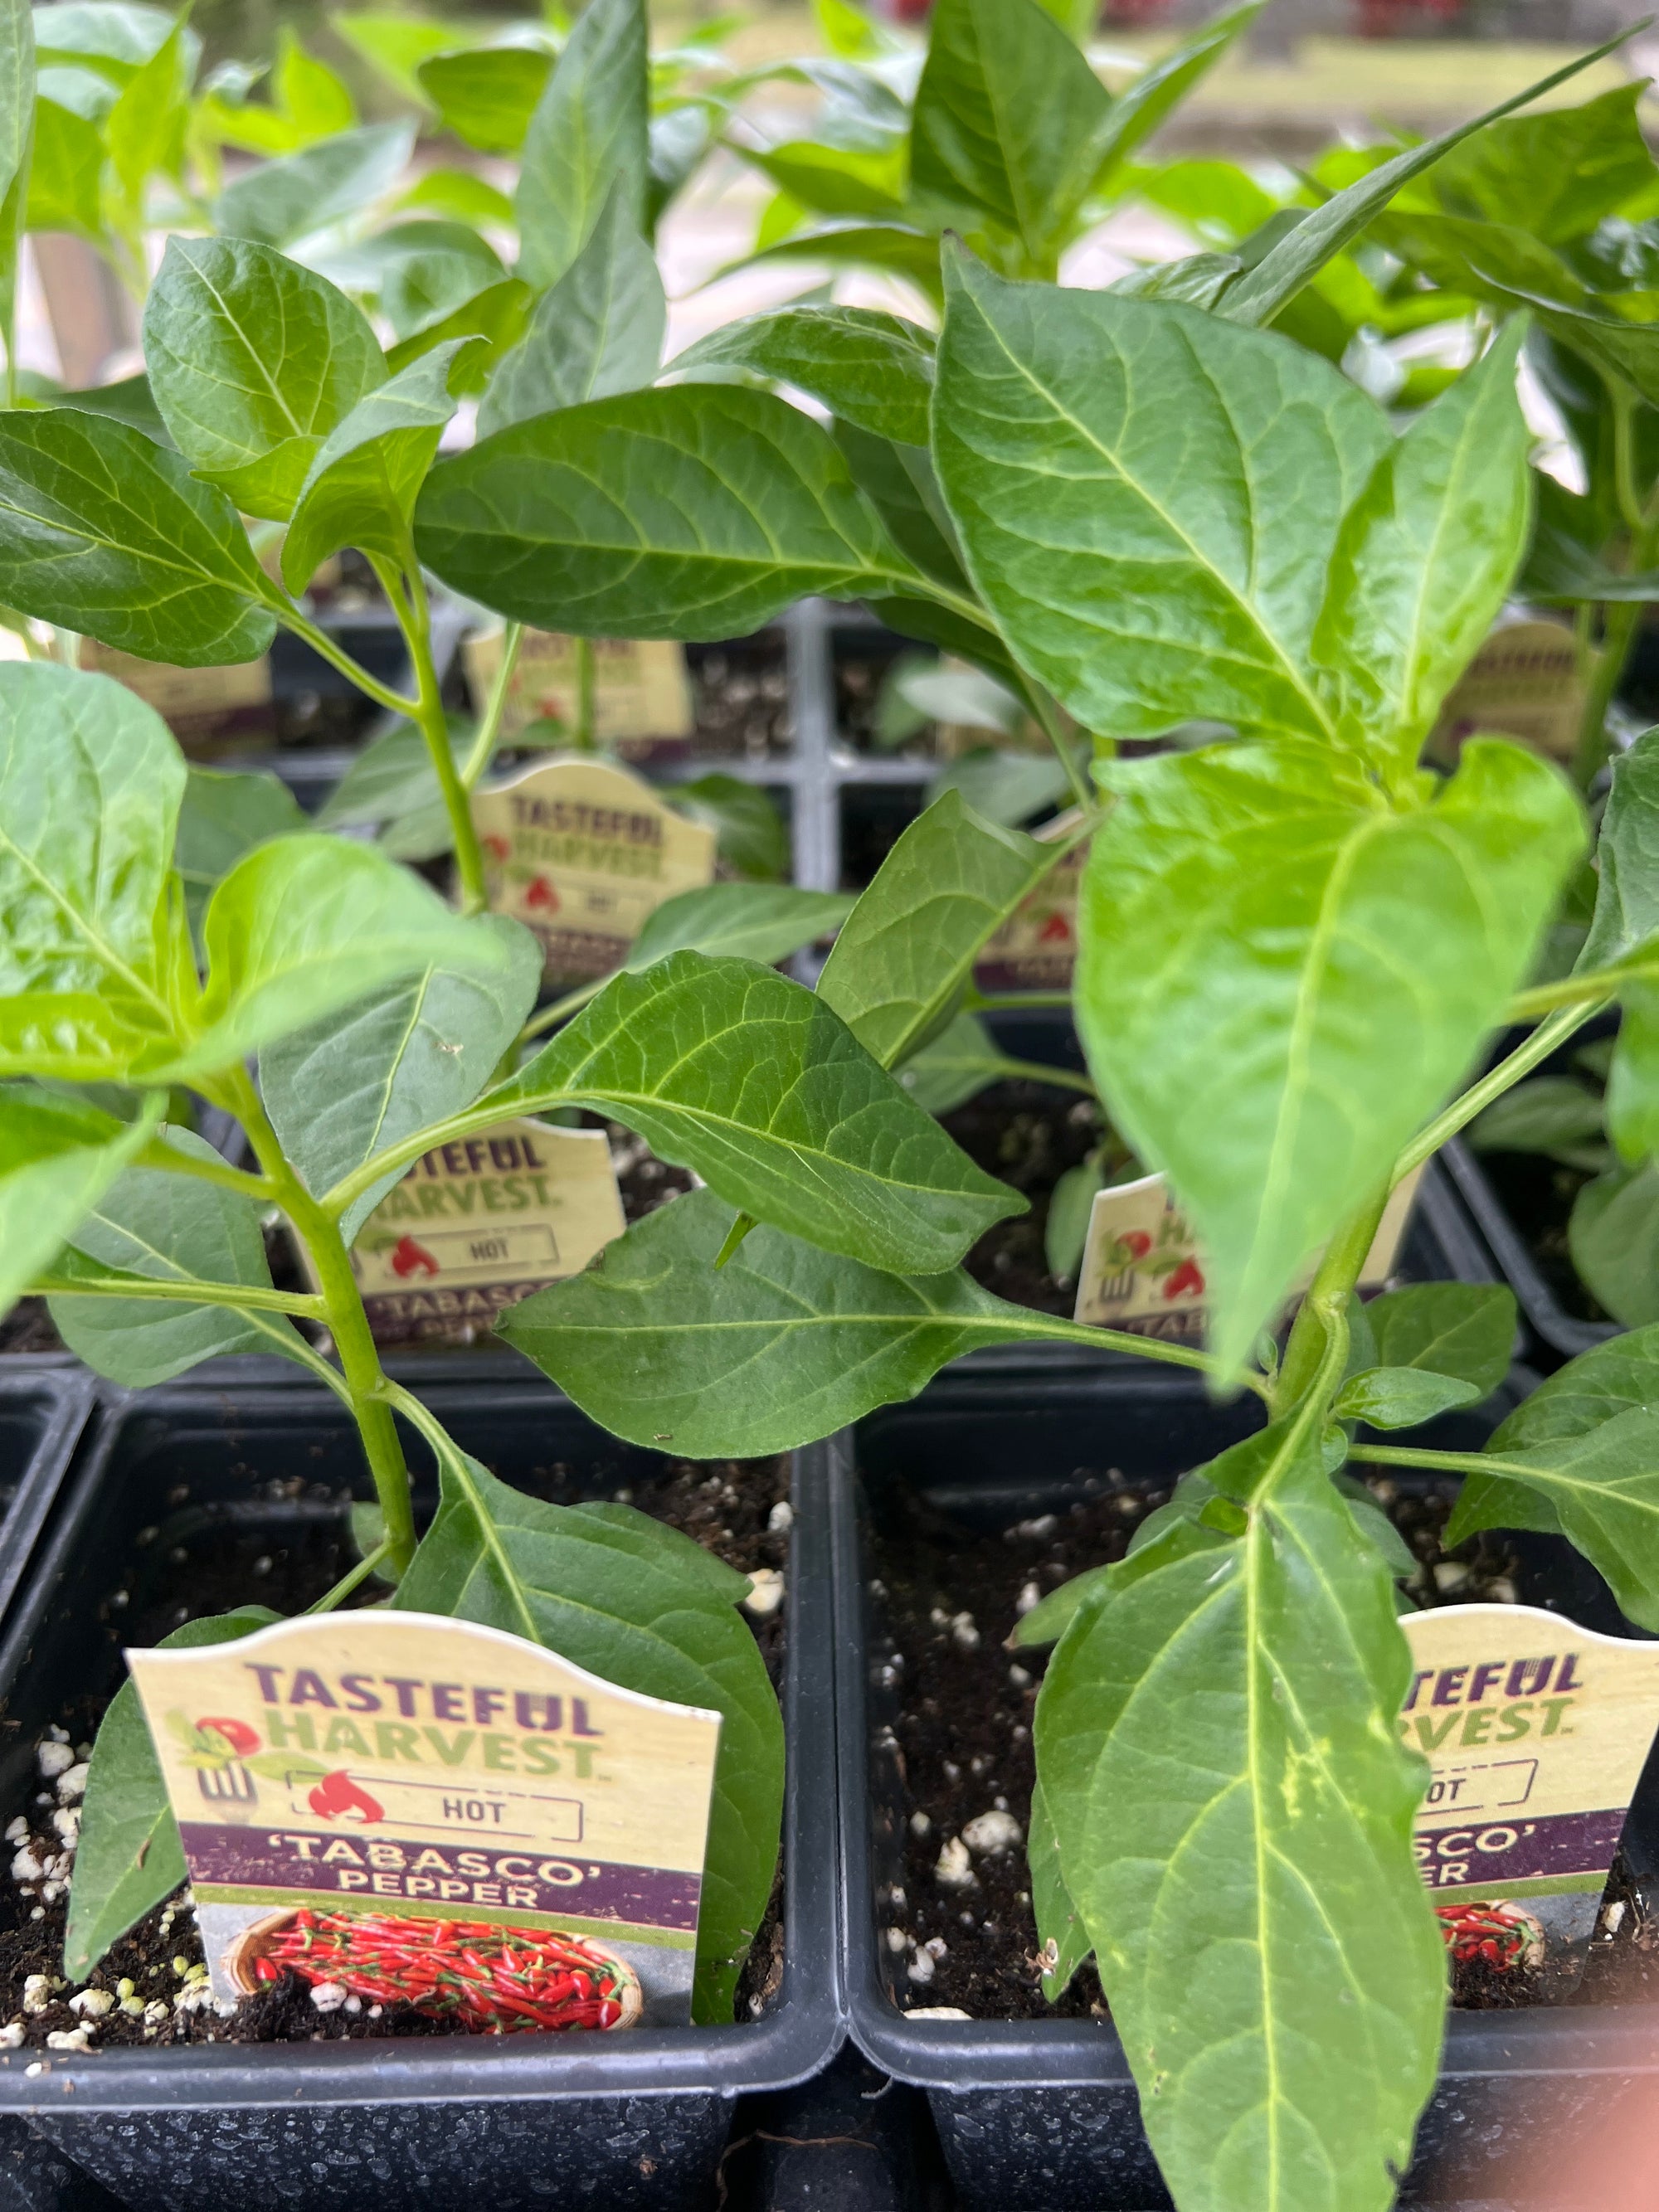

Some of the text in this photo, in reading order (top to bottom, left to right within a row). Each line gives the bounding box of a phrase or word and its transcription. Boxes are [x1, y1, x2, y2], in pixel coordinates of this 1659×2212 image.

[405, 1136, 545, 1179] TEFUL
[373, 1175, 551, 1218] ARVEST
[470, 1238, 509, 1260] HOT
[245, 1662, 606, 1736] TASTEFUL
[1403, 1652, 1583, 1710] TEFUL
[264, 1709, 603, 1782] HARVEST
[1398, 1697, 1574, 1752] VEST
[443, 1797, 506, 1824] HOT
[1427, 1777, 1467, 1803] OT
[268, 1834, 601, 1887] 'TABASCO'
[338, 1869, 539, 1908] PEPPER
